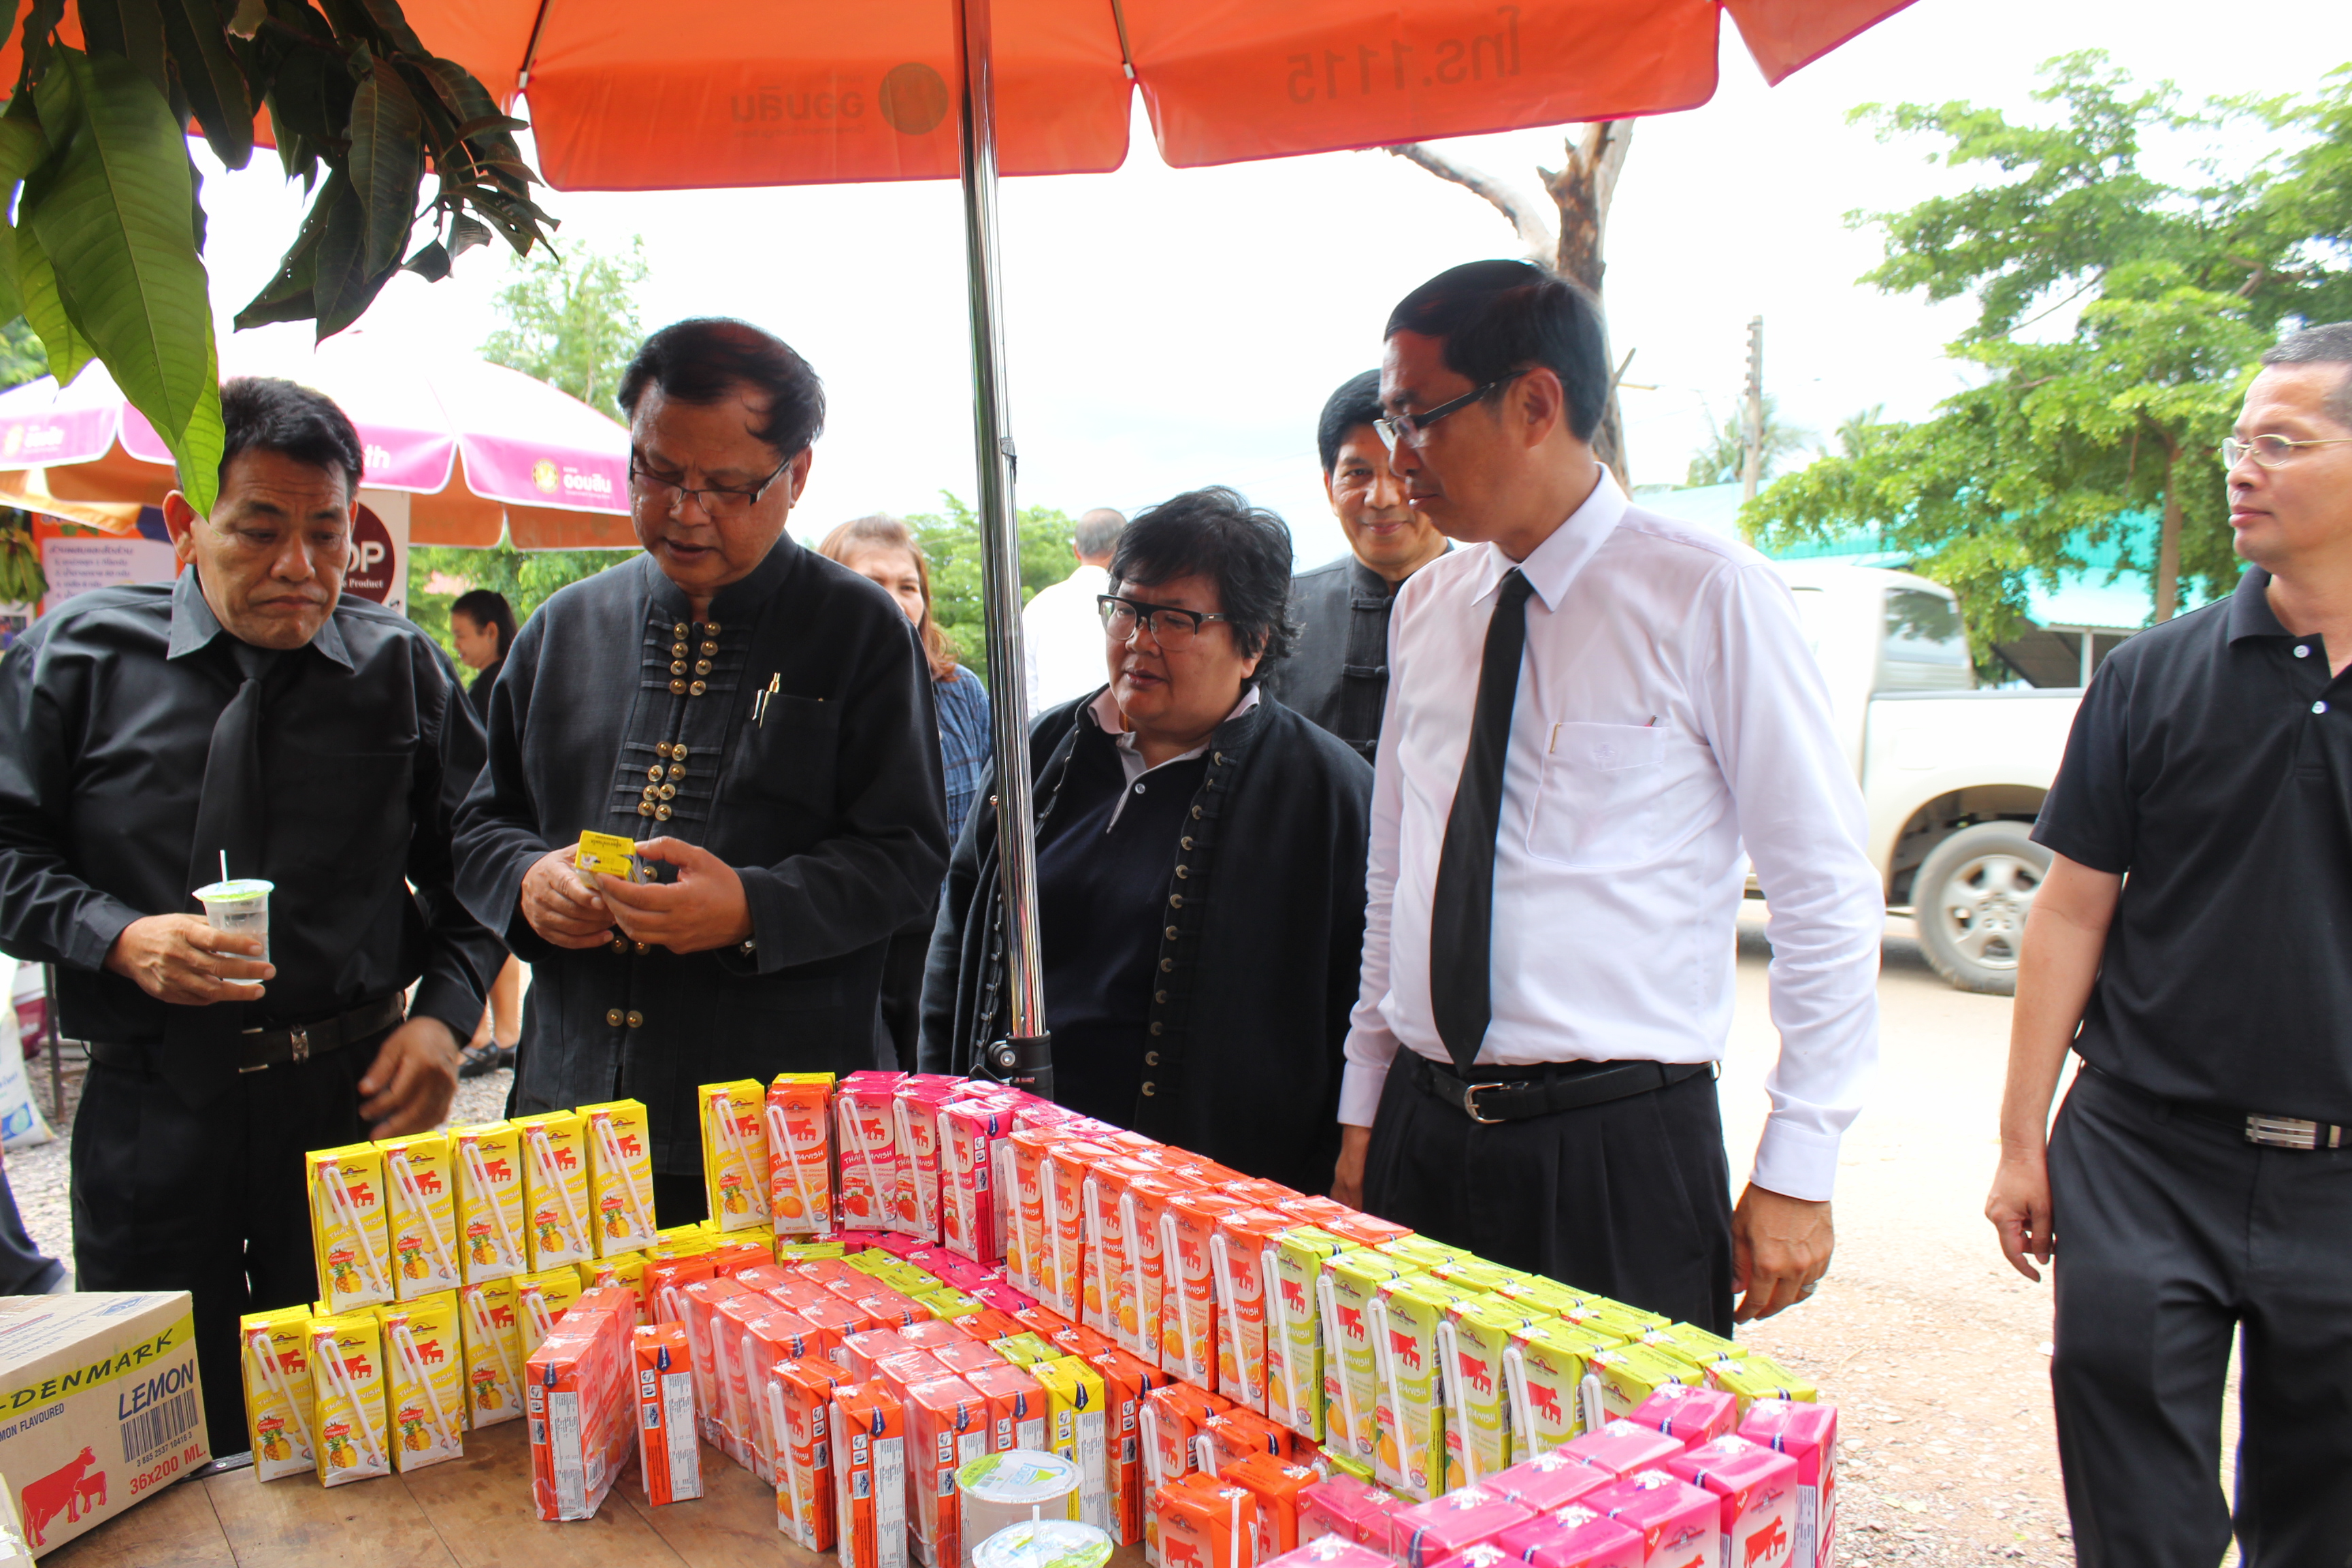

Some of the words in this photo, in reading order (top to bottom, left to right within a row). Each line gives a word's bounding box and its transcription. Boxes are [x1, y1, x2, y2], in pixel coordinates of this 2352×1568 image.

[564, 472, 612, 493] ออมสิน
[349, 578, 384, 589] Product
[118, 1358, 194, 1421] LEMON
[20, 1403, 65, 1432] FLAVOURED
[137, 1459, 141, 1467] 3
[142, 1452, 154, 1465] 885
[154, 1443, 169, 1458] 2537
[189, 1431, 193, 1439] 3
[129, 1455, 179, 1495] 36x200
[184, 1443, 206, 1465] ML.
